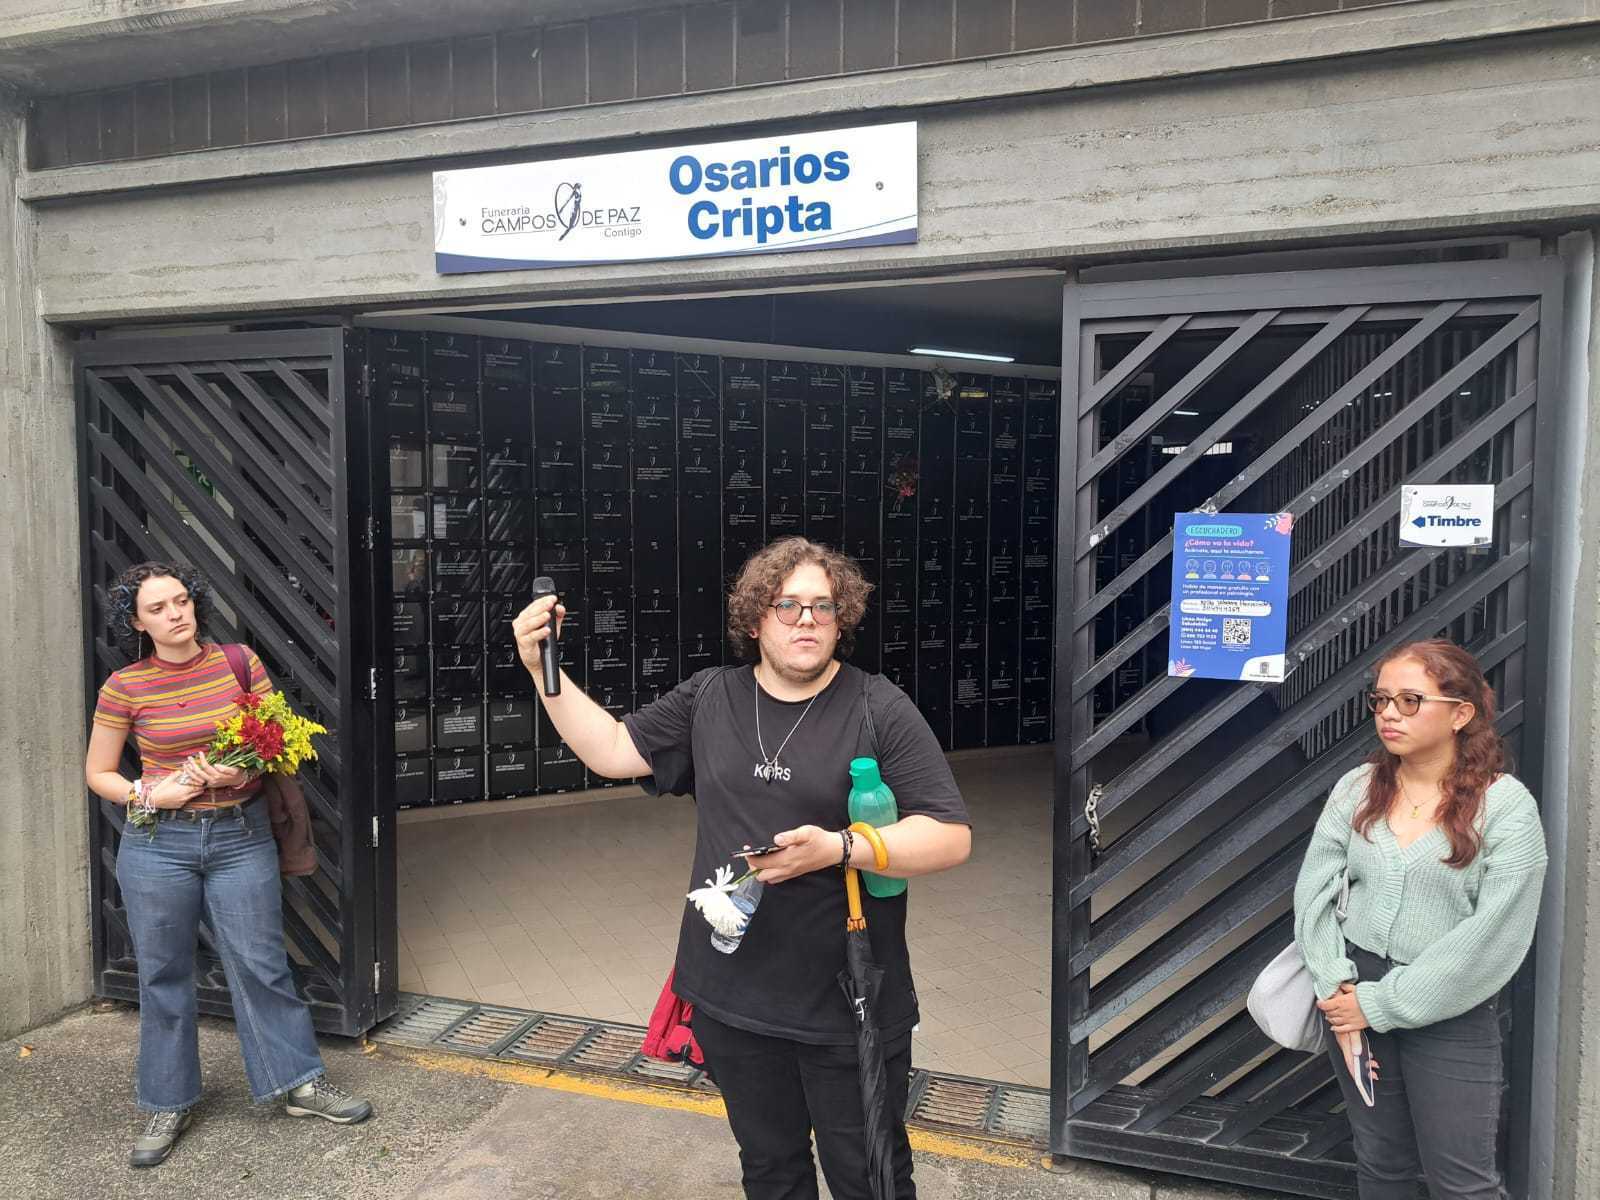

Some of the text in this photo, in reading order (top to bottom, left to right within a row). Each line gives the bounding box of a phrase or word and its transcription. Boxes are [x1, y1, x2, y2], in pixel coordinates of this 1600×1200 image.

[669, 146, 850, 195] Osarios
[481, 205, 530, 218] Funeraria
[481, 206, 641, 234] CAMPOS DE PAZ
[687, 195, 832, 244] Cripta
[604, 227, 643, 238] Contigo
[1427, 515, 1481, 527] Timbre
[1190, 526, 1238, 535] ESCUCHADERO
